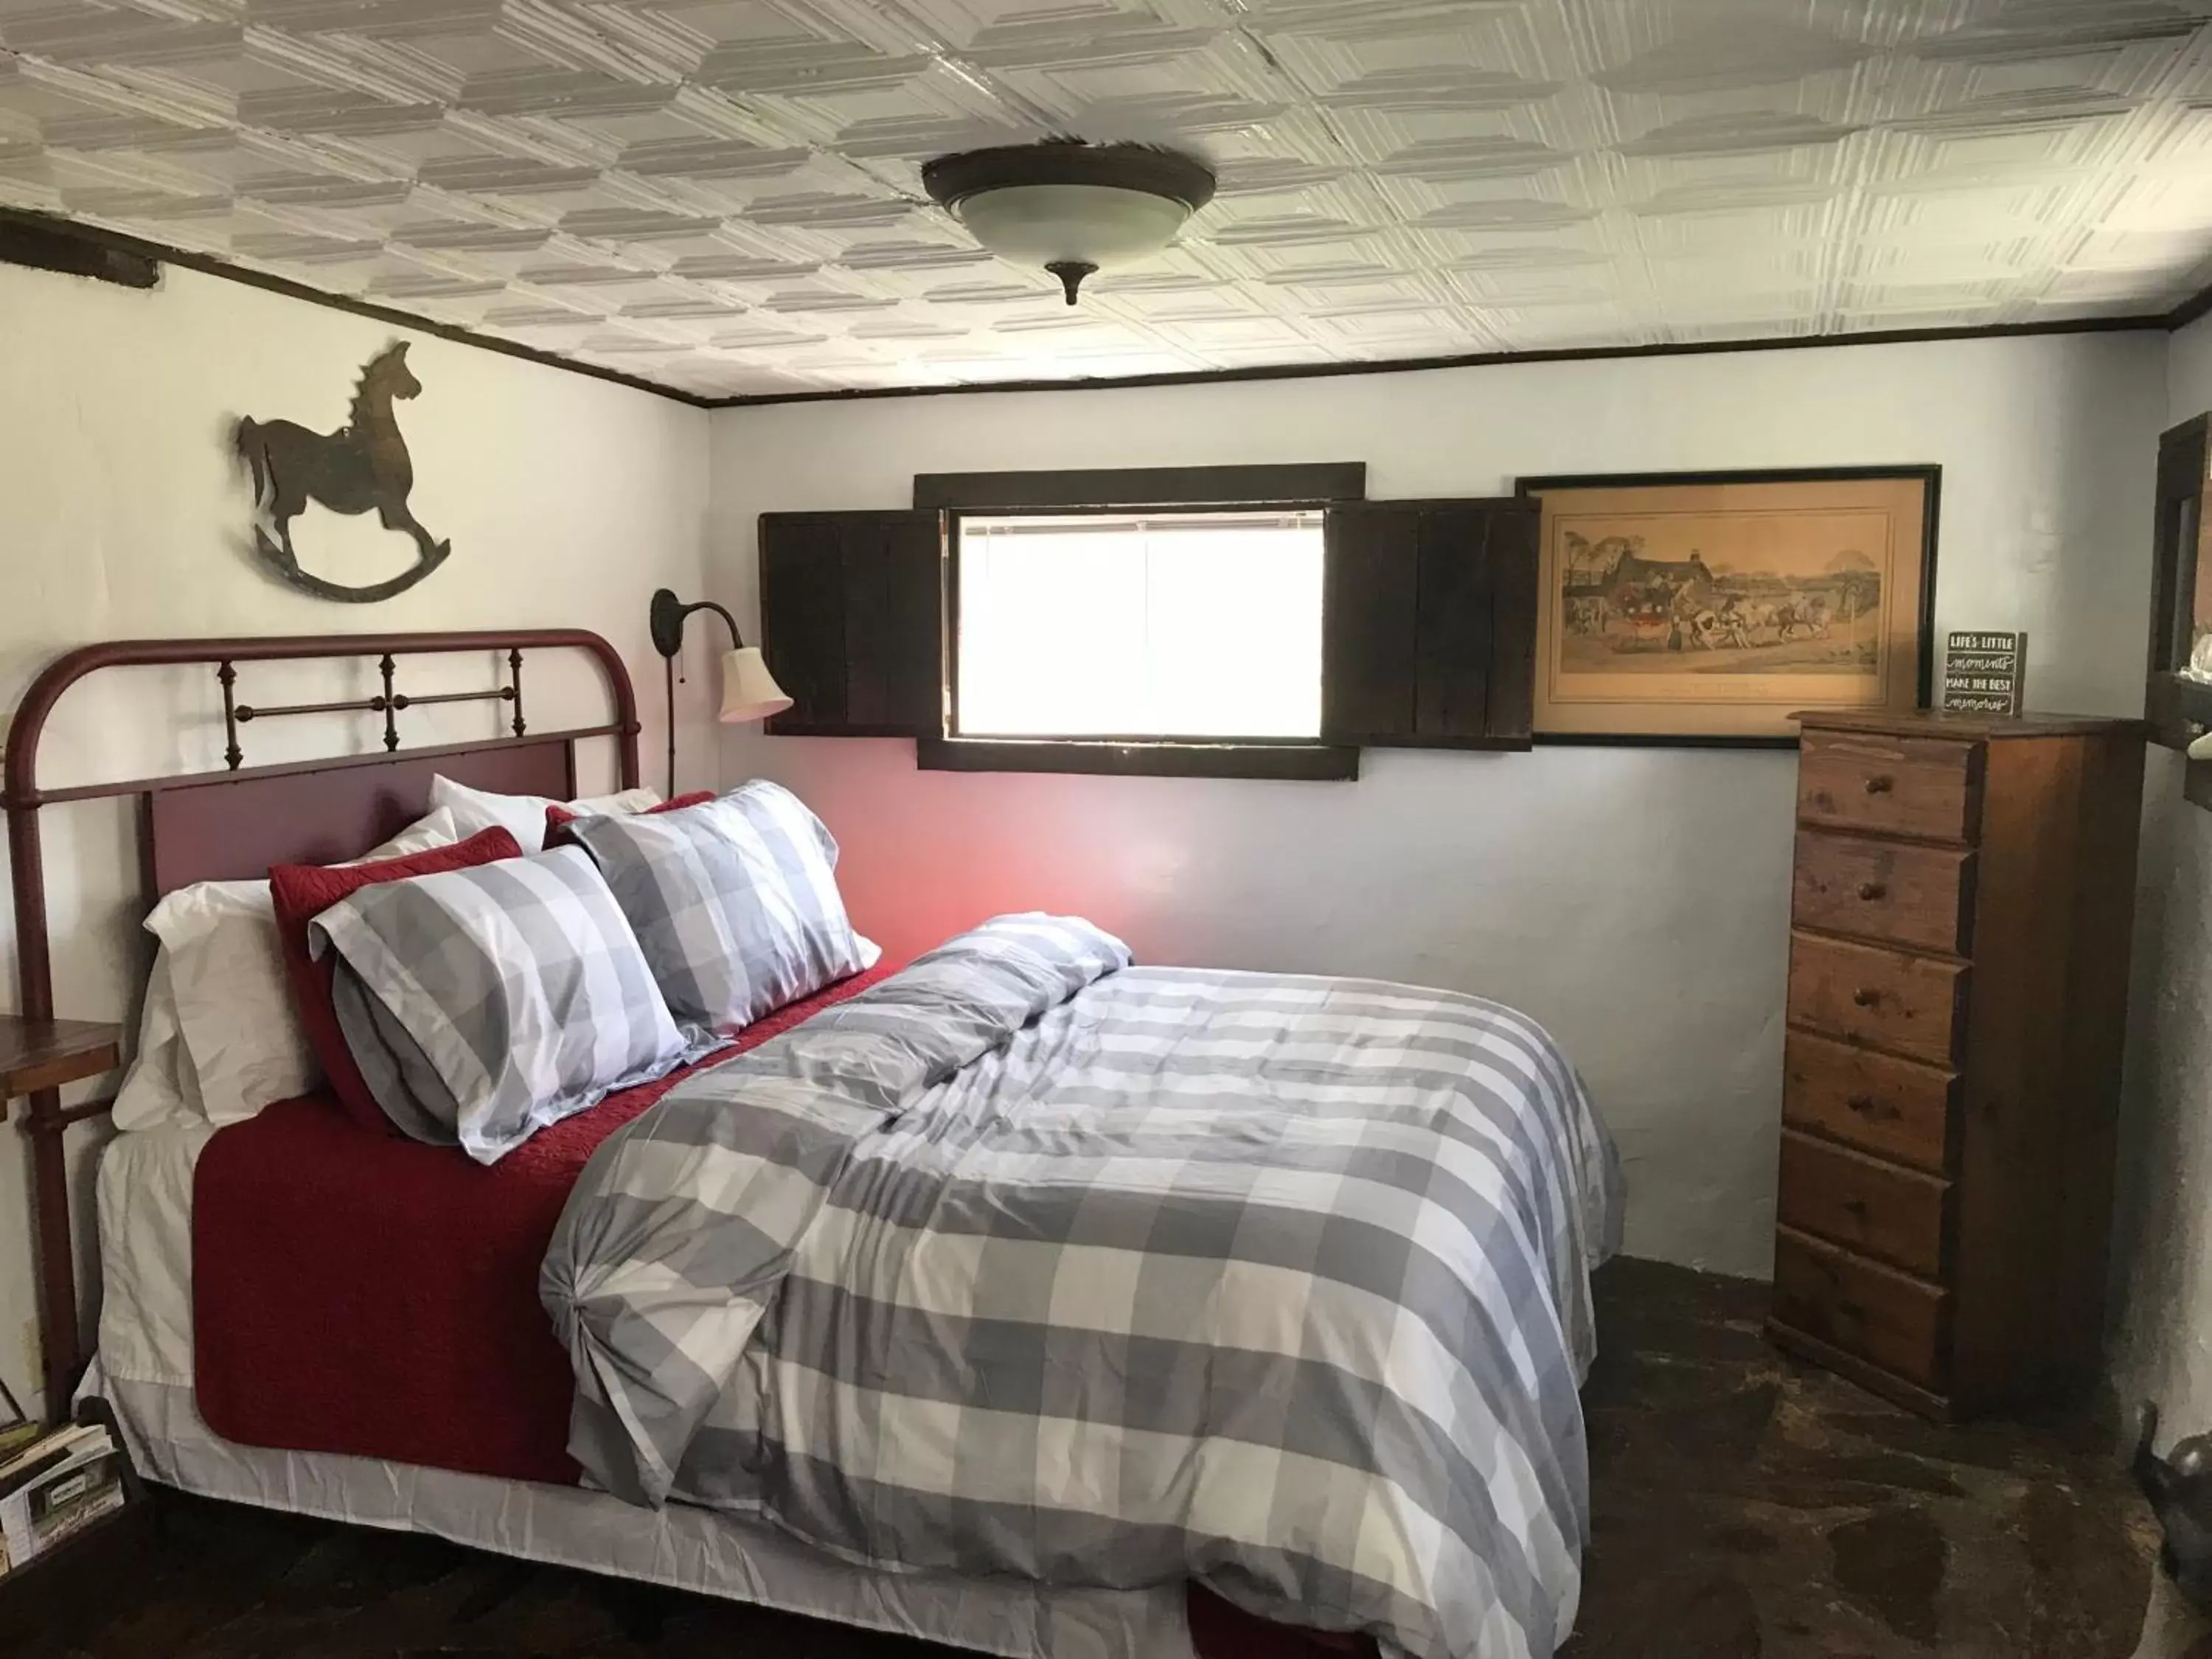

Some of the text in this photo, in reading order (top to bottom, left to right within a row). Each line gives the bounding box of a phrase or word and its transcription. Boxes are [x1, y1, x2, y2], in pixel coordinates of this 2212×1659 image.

[1950, 635, 2013, 650] LIFE'S LITTLE
[1947, 678, 2011, 691] MAKE THE BEST
